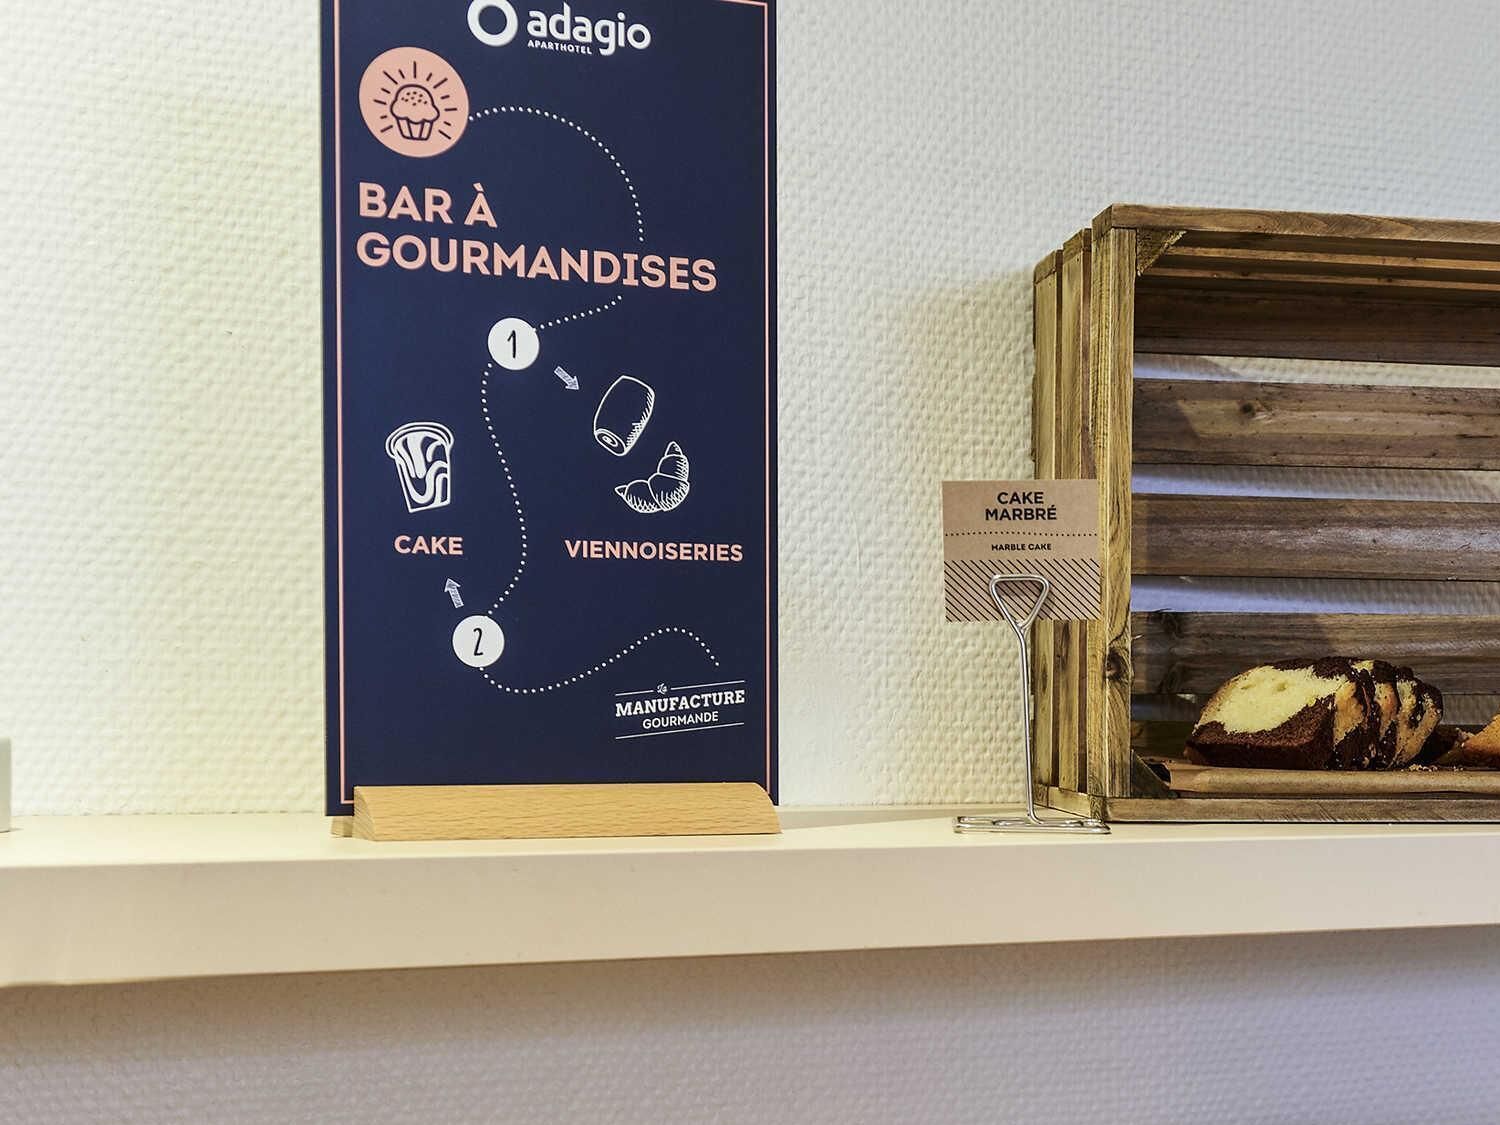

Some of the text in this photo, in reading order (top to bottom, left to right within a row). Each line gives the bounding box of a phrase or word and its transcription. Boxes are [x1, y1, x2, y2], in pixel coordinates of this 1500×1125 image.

[527, 1, 651, 56] adagio
[527, 39, 592, 55] APARTHOTEL
[358, 181, 498, 229] BAR À
[355, 231, 718, 292] GOURMANDISES
[507, 329, 517, 358] 1
[997, 492, 1044, 504] CAKE
[985, 505, 1057, 521] MARBRÉ
[393, 535, 464, 556] CAKE
[564, 539, 744, 563] VIENNOISERIES
[991, 543, 1052, 551] MARBLE CAKE
[472, 627, 484, 656] 2
[615, 689, 746, 718] MANUFACTURE
[642, 711, 719, 730] GOURMANDE
